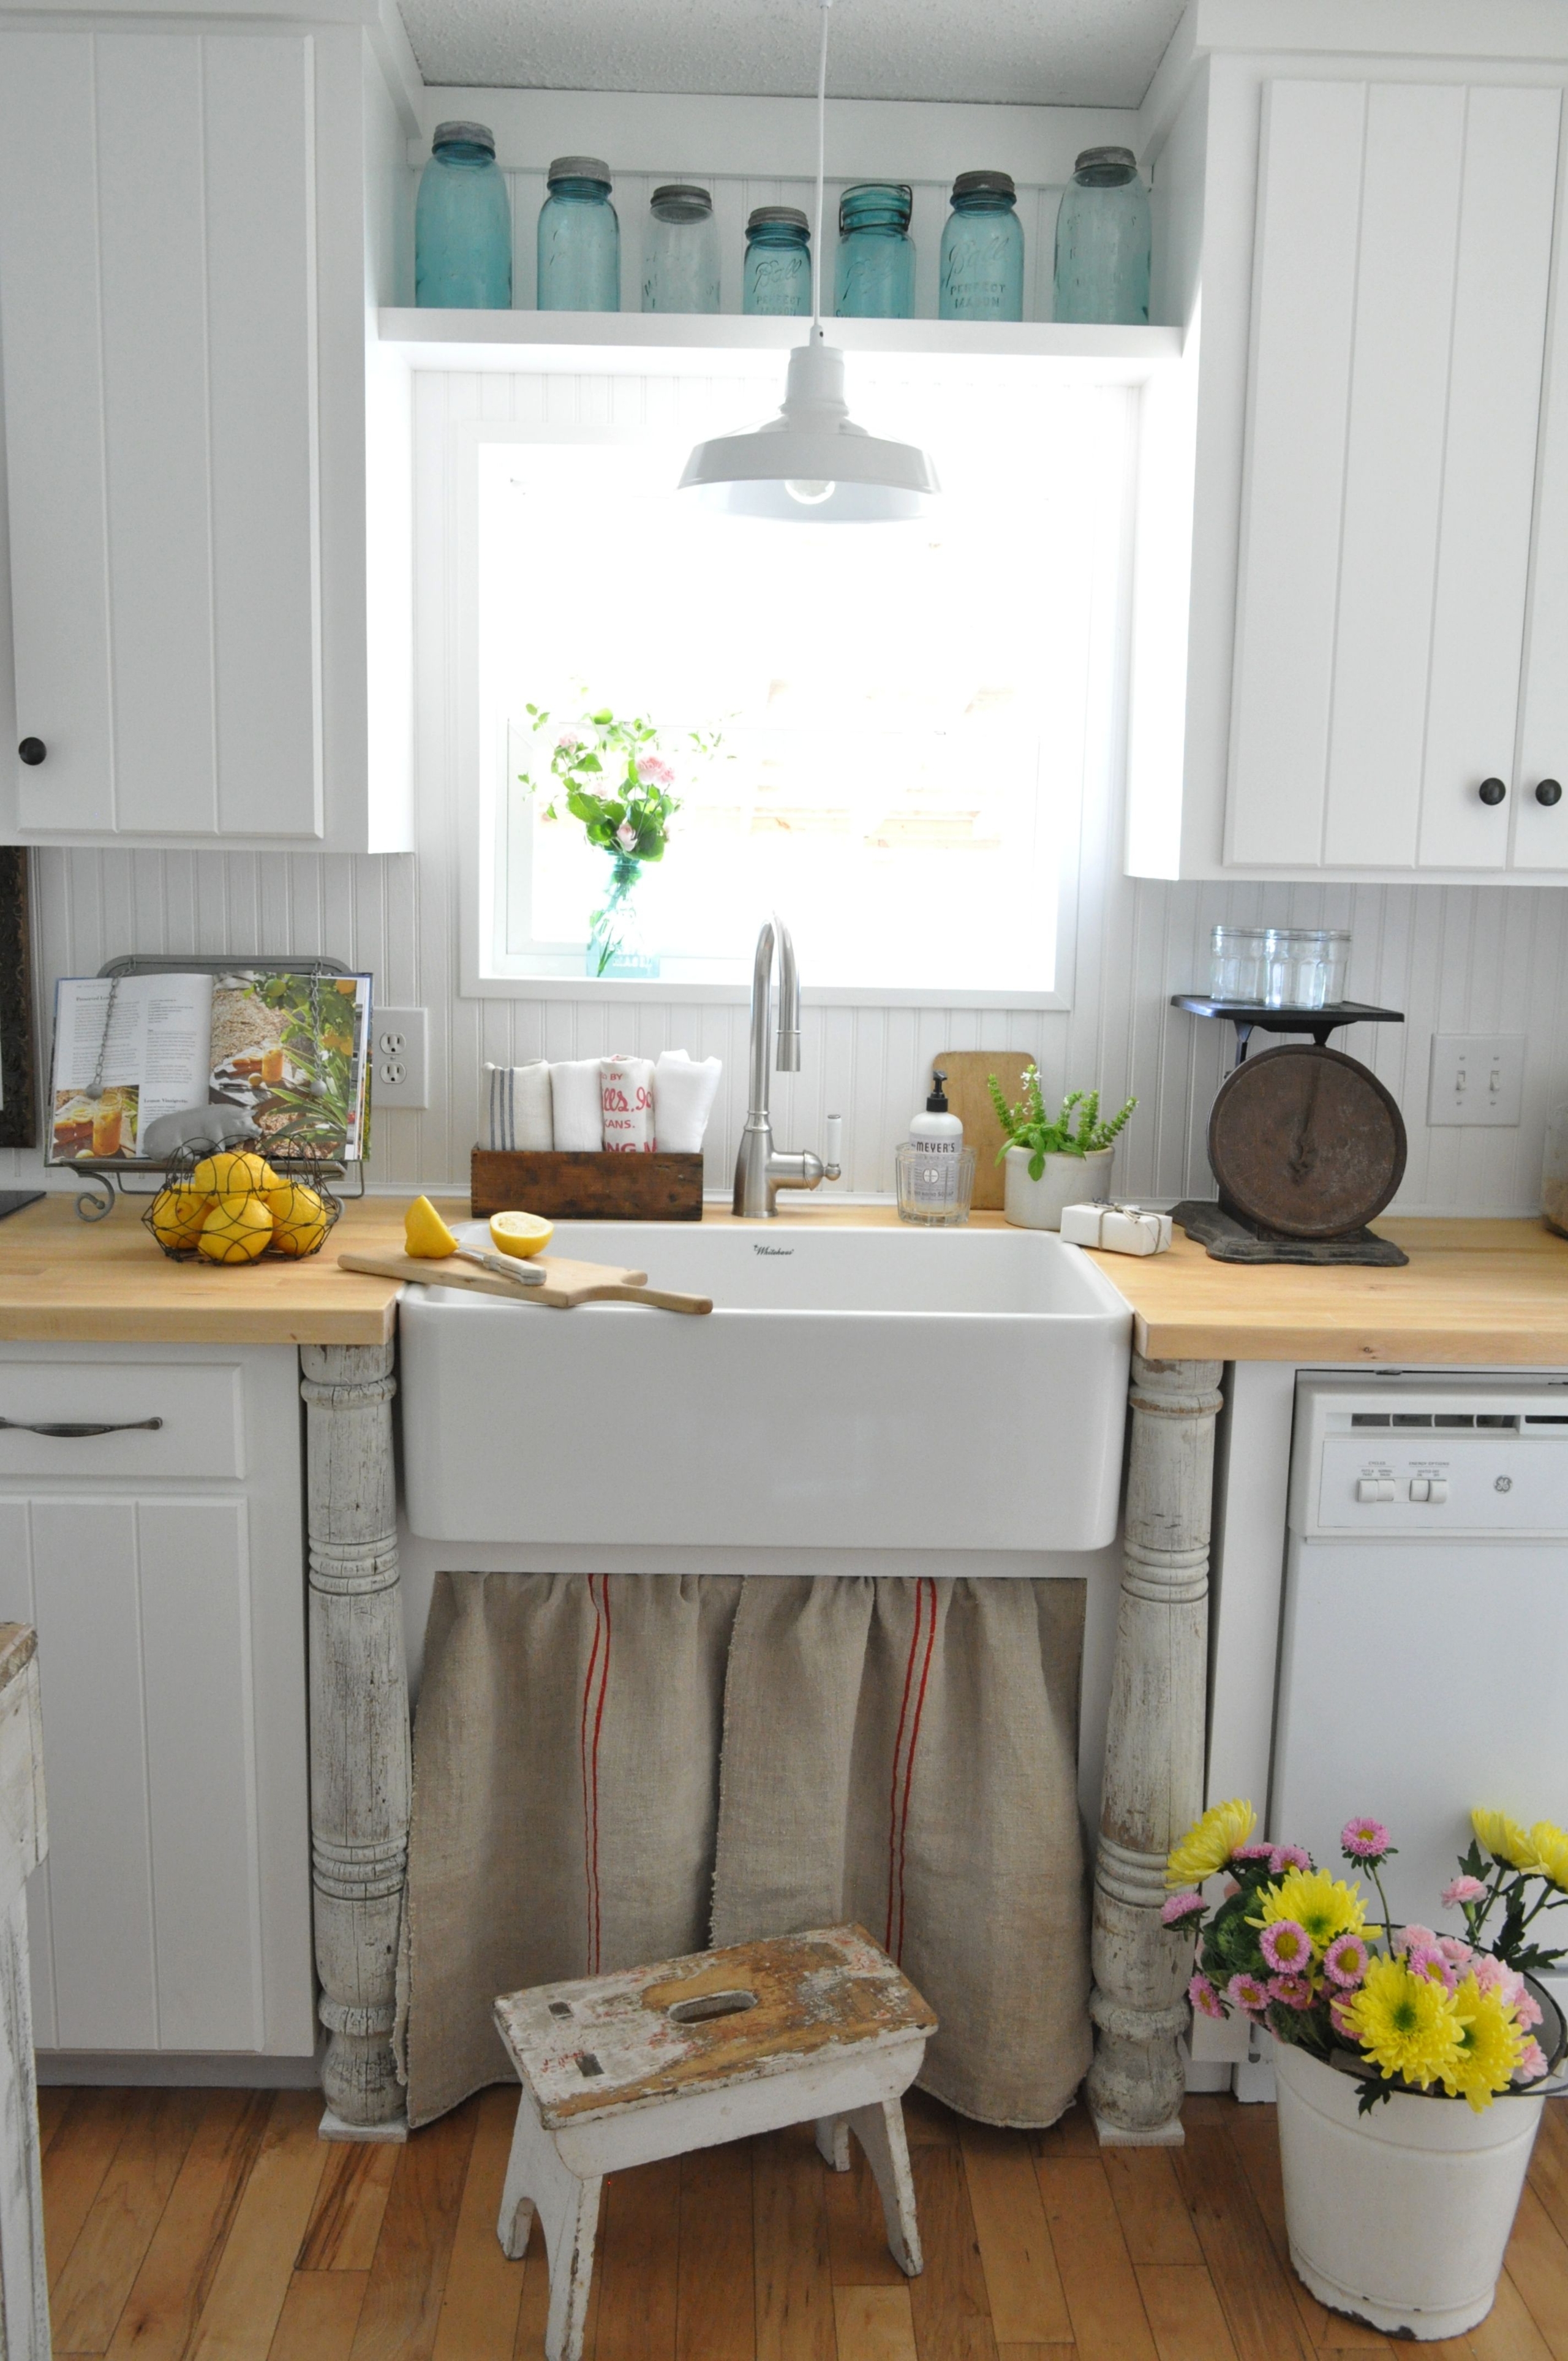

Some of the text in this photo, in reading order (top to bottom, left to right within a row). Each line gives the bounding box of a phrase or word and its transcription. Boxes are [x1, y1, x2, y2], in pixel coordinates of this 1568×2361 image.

[753, 259, 802, 294] Ball
[946, 235, 1009, 289] Ball
[603, 1087, 633, 1112] lls.
[916, 1141, 955, 1154] MEYER'S
